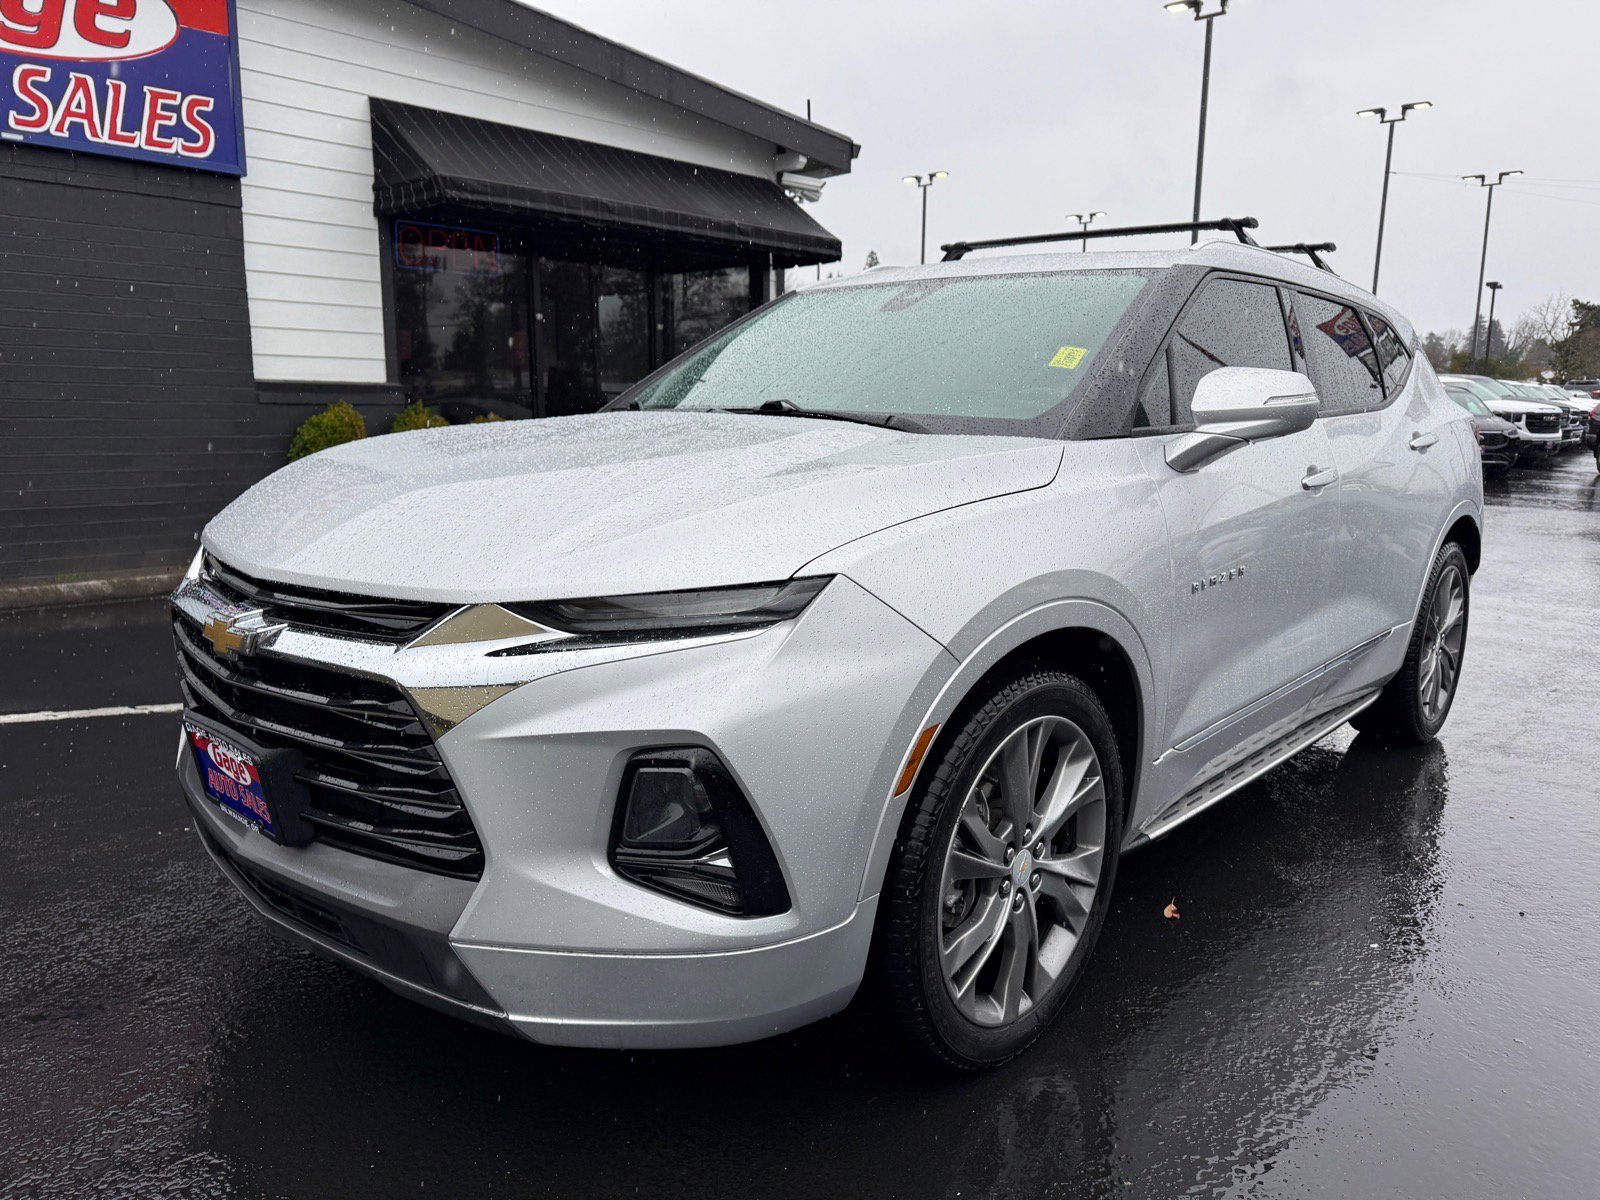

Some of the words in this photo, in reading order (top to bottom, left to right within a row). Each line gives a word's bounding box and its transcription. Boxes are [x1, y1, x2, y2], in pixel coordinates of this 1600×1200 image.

[8, 63, 215, 158] SALES
[399, 226, 496, 272] OPEN
[1191, 565, 1246, 594] BLAZER
[211, 743, 248, 783] Gage
[208, 767, 239, 801] AUTO
[239, 784, 272, 824] SALES
